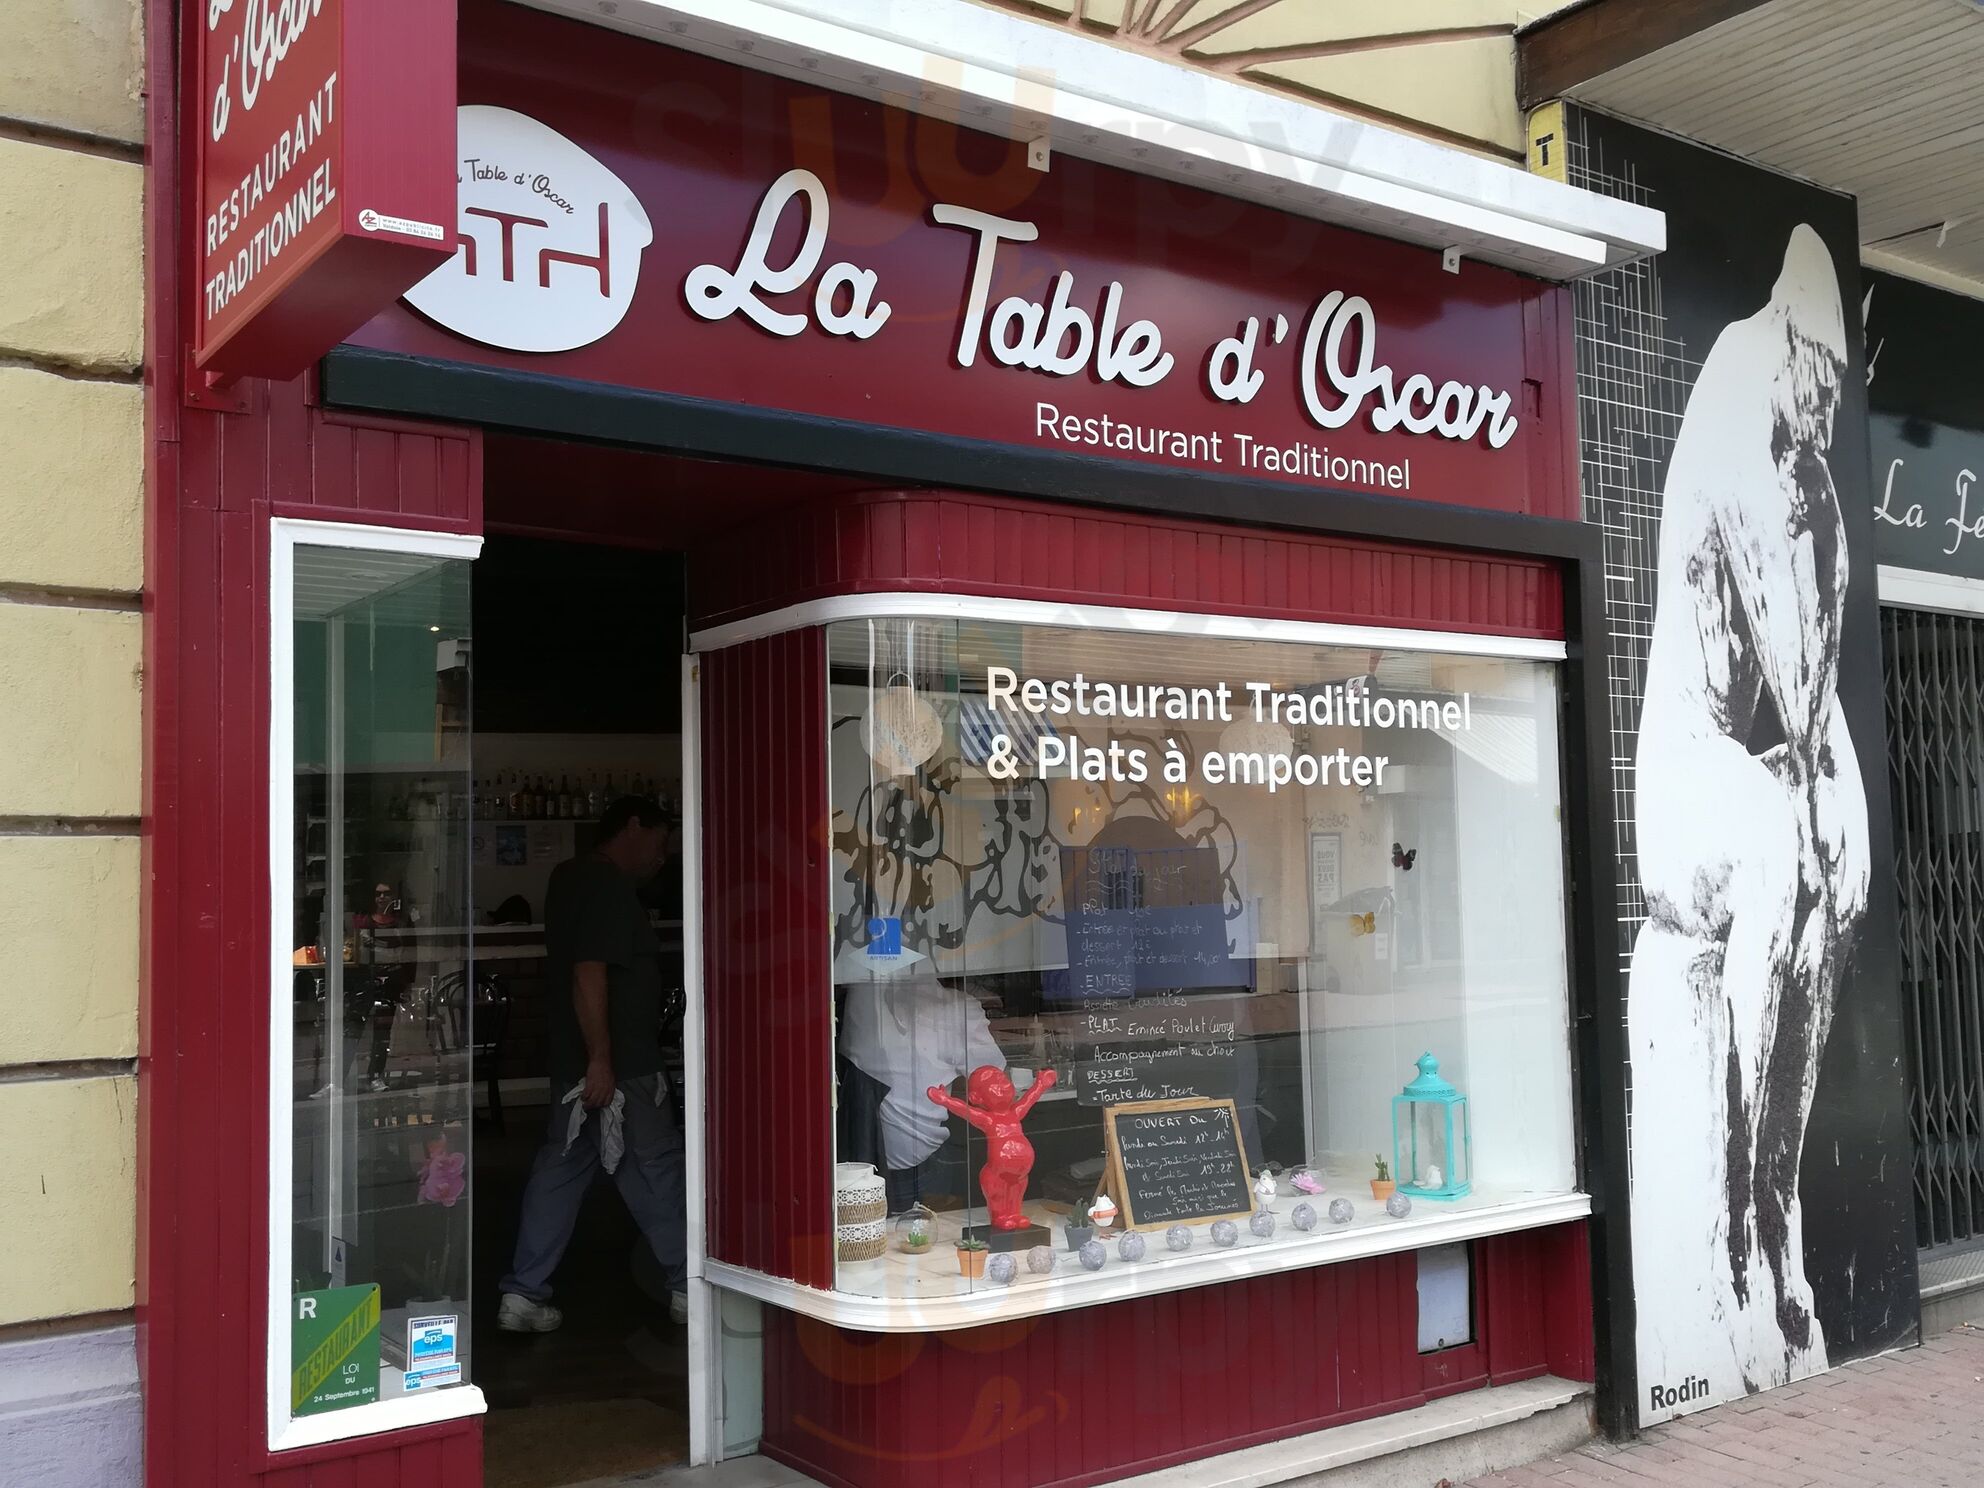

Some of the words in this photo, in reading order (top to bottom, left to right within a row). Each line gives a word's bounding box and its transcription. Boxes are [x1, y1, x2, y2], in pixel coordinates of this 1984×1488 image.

[207, 71, 337, 257] RESTAURANT
[464, 158, 508, 182] Table
[513, 173, 574, 214] d'Oscar
[206, 158, 336, 320] TRADITIONNEL
[685, 169, 891, 339] La
[933, 203, 1175, 386] Table
[1210, 290, 1517, 448] d'Oscar
[1036, 402, 1222, 463] Restaurant
[1234, 432, 1410, 490] Traditionnel
[1874, 458, 1927, 528] La
[987, 666, 1232, 721] Restaurant
[1246, 682, 1471, 731] Traditionnel
[987, 737, 1019, 780] &
[1039, 737, 1147, 783] Plats
[1164, 736, 1187, 783] à
[1202, 750, 1388, 793] emporter
[1136, 1085, 1157, 1099] du
[1135, 1117, 1182, 1129] OUVERT
[299, 1298, 317, 1320] R
[299, 1297, 372, 1400] RESTAURANT
[424, 1333, 443, 1345] eps
[325, 1390, 360, 1401] Septembre
[362, 1387, 375, 1395] 1941
[342, 1363, 360, 1375] LOI
[345, 1377, 356, 1385] DU
[1651, 1376, 1709, 1411] Rodin
